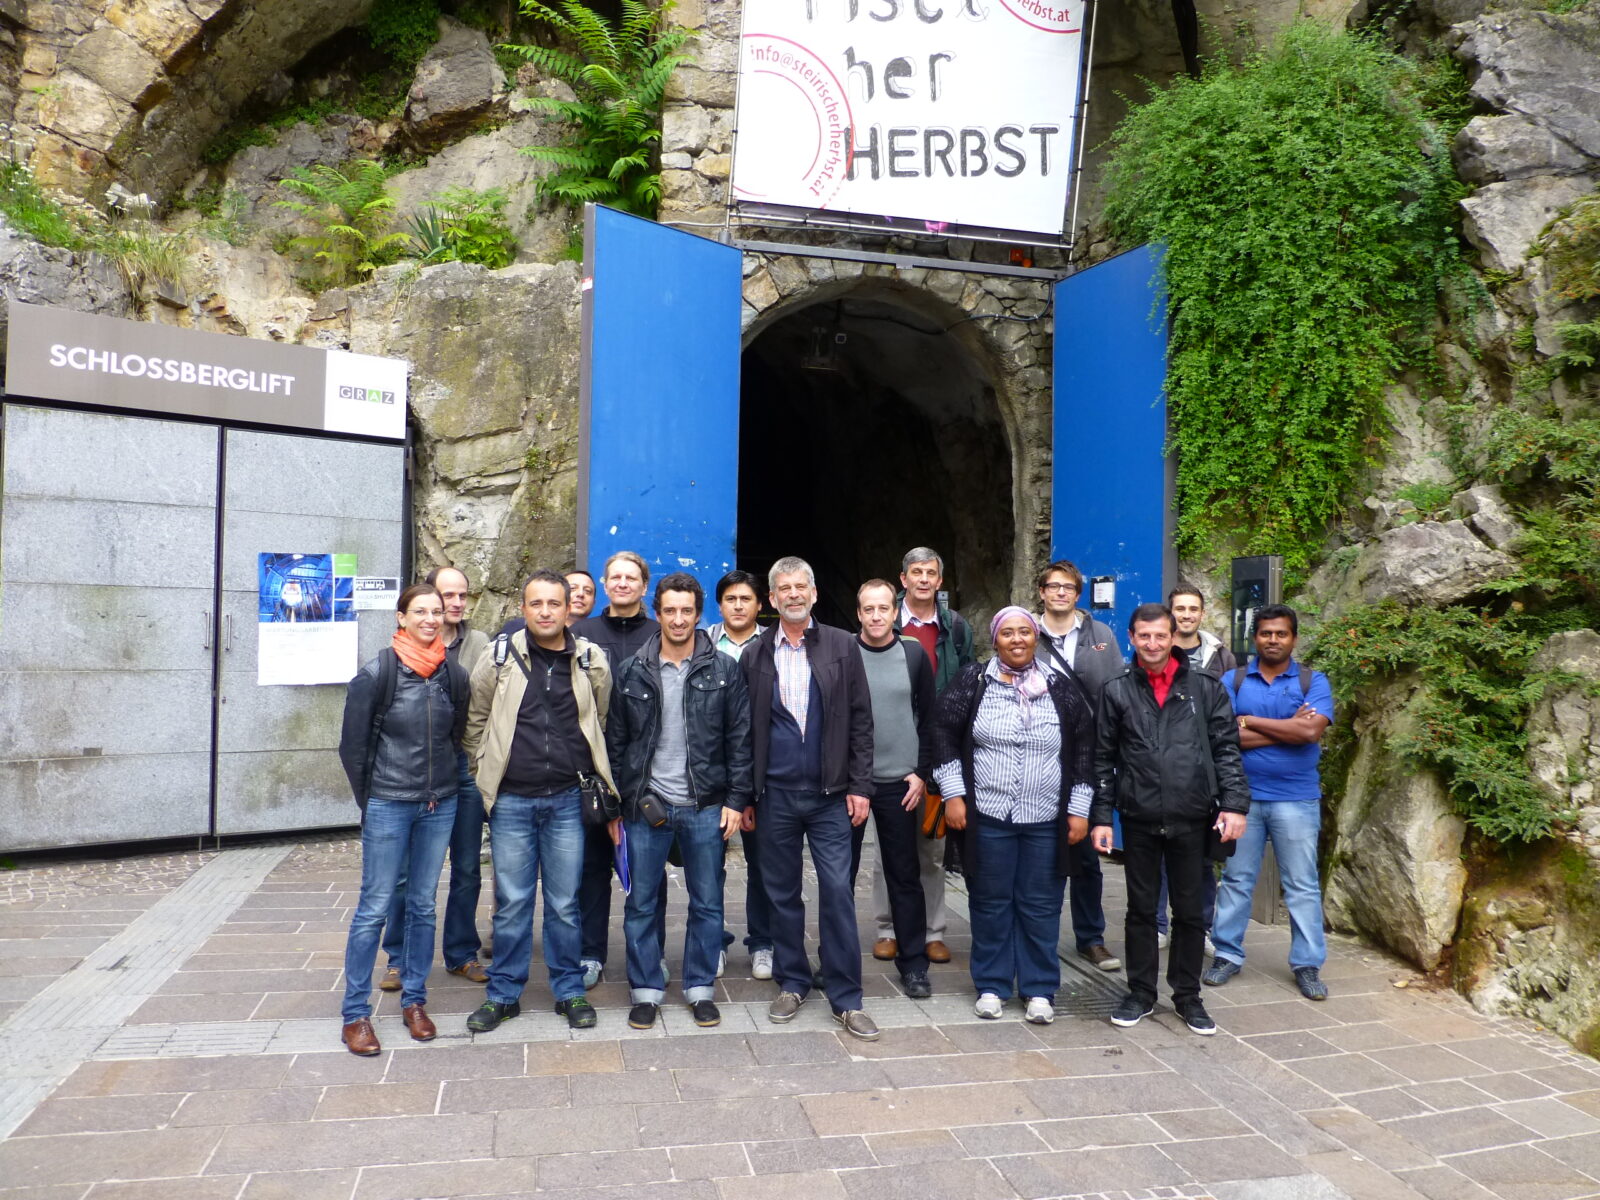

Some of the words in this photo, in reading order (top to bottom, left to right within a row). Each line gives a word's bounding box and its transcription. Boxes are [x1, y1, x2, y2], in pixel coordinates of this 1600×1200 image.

[843, 46, 956, 103] her
[843, 122, 1060, 181] HERBST
[49, 343, 295, 396] SCHLOSSBERGLIFT
[340, 386, 394, 404] GRAZ
